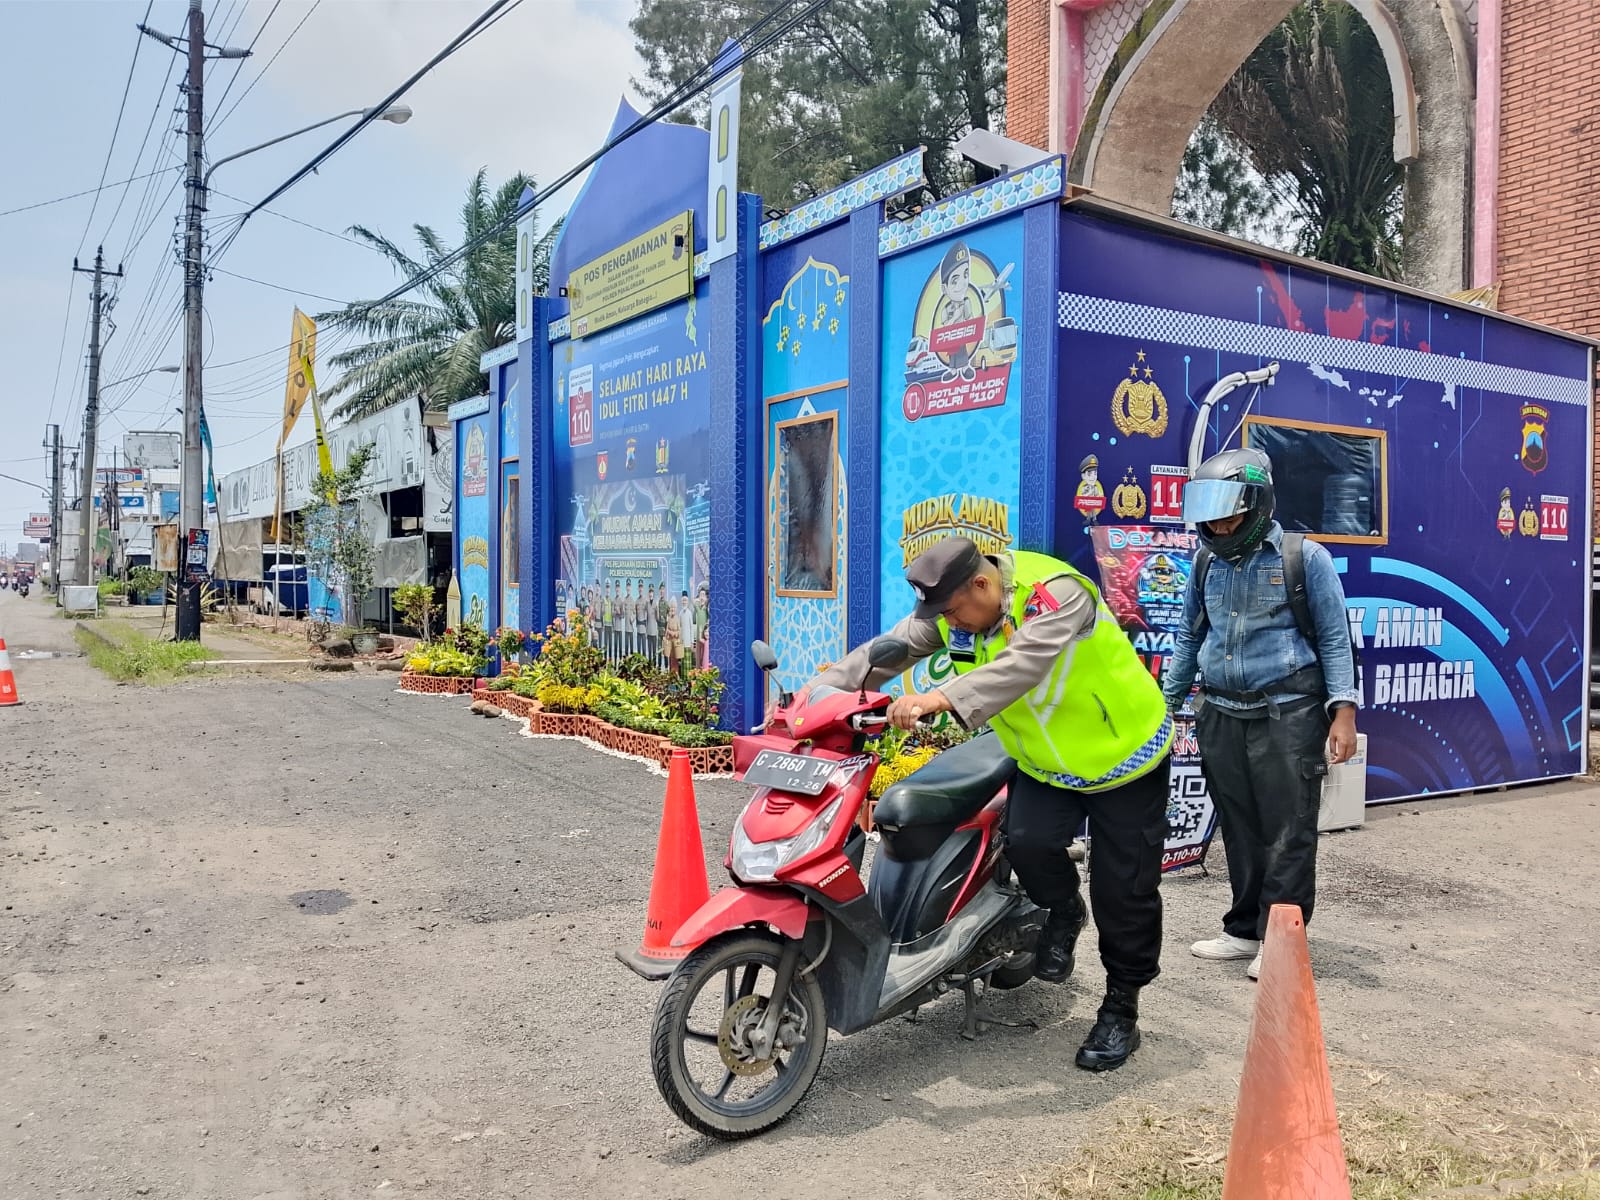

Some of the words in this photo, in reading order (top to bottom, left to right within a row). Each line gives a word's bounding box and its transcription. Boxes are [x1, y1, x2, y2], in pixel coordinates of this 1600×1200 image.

[583, 267, 600, 286] POS
[602, 232, 668, 276] PENGAMANAN
[936, 323, 977, 344] PRESISI
[599, 370, 643, 398] SELAMAT
[646, 360, 672, 385] HARI
[676, 351, 707, 376] RAYA
[928, 384, 970, 399] HOTLINE
[971, 376, 1006, 392] MUDIK
[599, 399, 620, 421] IDUL
[623, 391, 648, 415] FITRI
[651, 384, 676, 408] 1447
[681, 381, 688, 401] H
[928, 394, 964, 411] POLRI
[571, 409, 590, 435] 110
[1152, 465, 1178, 474] LAYANAN
[1179, 467, 1188, 475] PO
[1153, 480, 1183, 508] 11
[902, 492, 958, 537] MUDIK
[959, 492, 1009, 538] AMAN
[1542, 507, 1567, 529] 110
[903, 530, 953, 569] KELUAR
[1108, 528, 1198, 549] DEXANET
[1137, 592, 1184, 604] SIPOLA
[1373, 606, 1443, 648] AMAN
[1374, 660, 1475, 705] BAHAGIA
[756, 753, 769, 766] G
[768, 756, 806, 772] 2860
[813, 762, 835, 777] TM
[818, 864, 850, 889] HONDA
